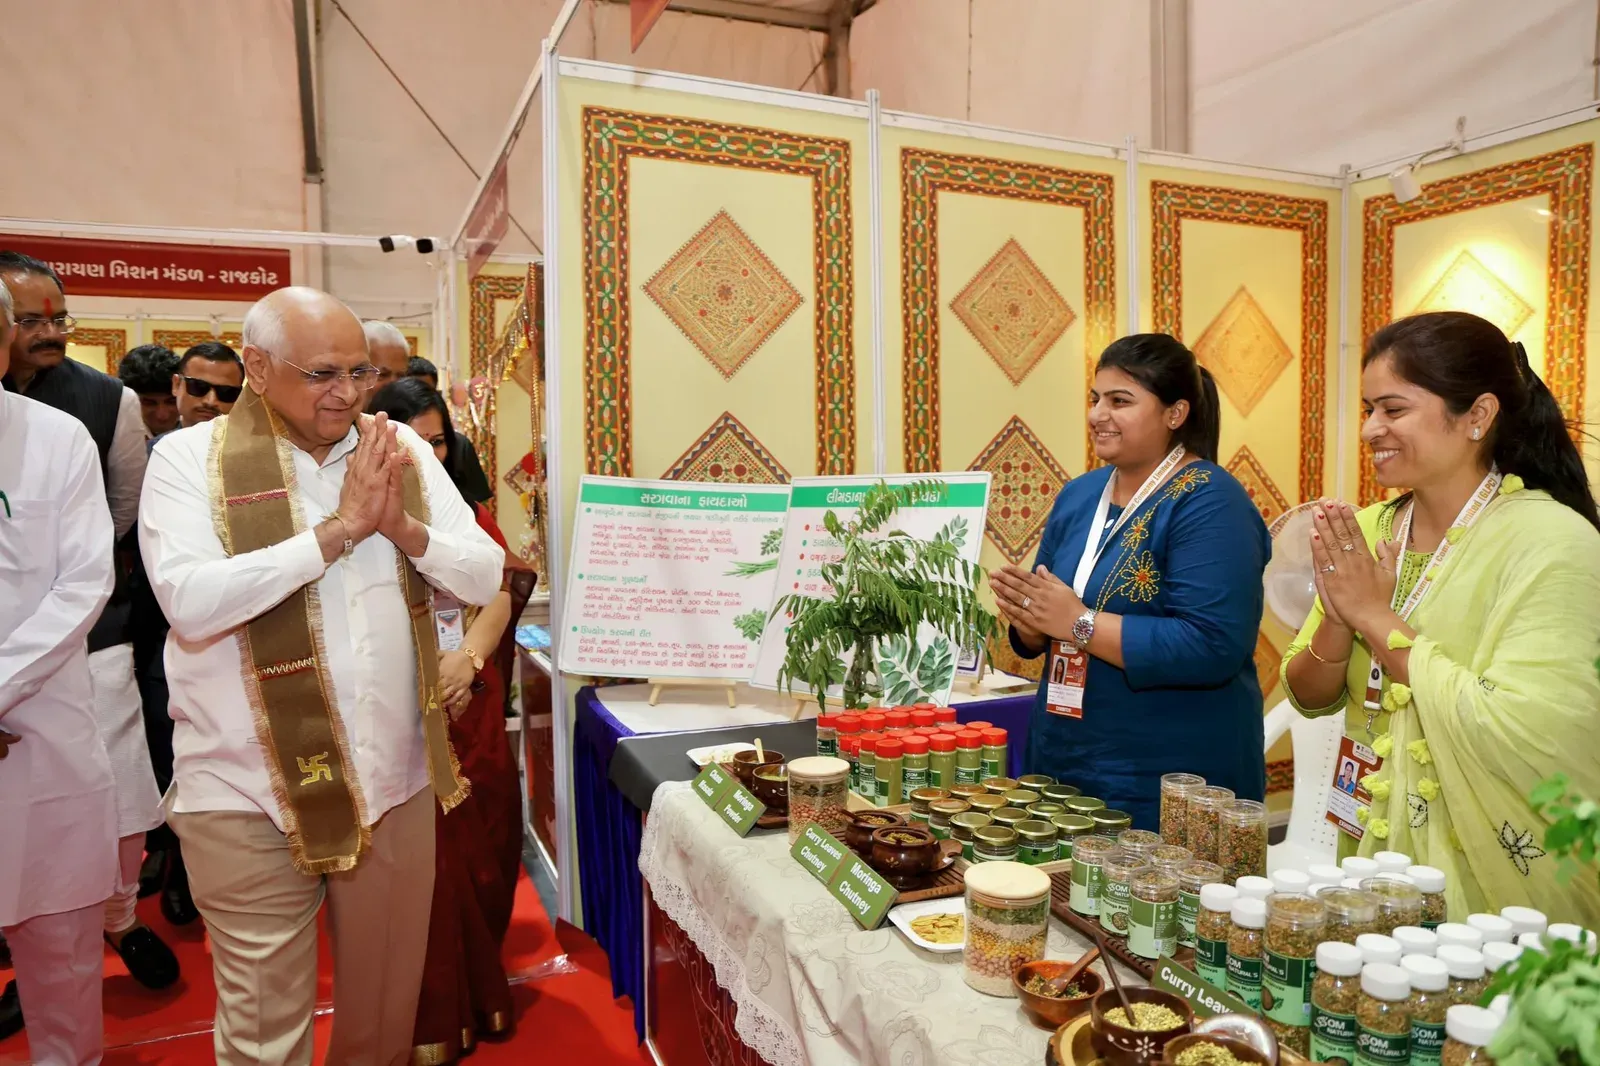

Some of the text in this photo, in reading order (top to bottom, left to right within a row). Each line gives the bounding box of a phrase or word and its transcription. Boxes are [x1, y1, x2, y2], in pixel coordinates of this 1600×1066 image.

[110, 260, 159, 280] મિશન
[163, 263, 203, 282] મંડળ
[219, 267, 278, 285] રાજકોટ
[1134, 481, 1155, 504] Company
[1153, 462, 1171, 481] Limited
[1478, 477, 1498, 500] (GLPC)
[639, 491, 747, 508] સરગવાના ફાયદાઓ
[723, 803, 743, 824] Powder
[733, 789, 755, 812] Moringa
[805, 827, 842, 860] Curry Leaves
[800, 846, 827, 873] Chutney
[850, 862, 882, 895] Moringa
[839, 881, 871, 916] Chutney
[1160, 966, 1196, 999] Curry
